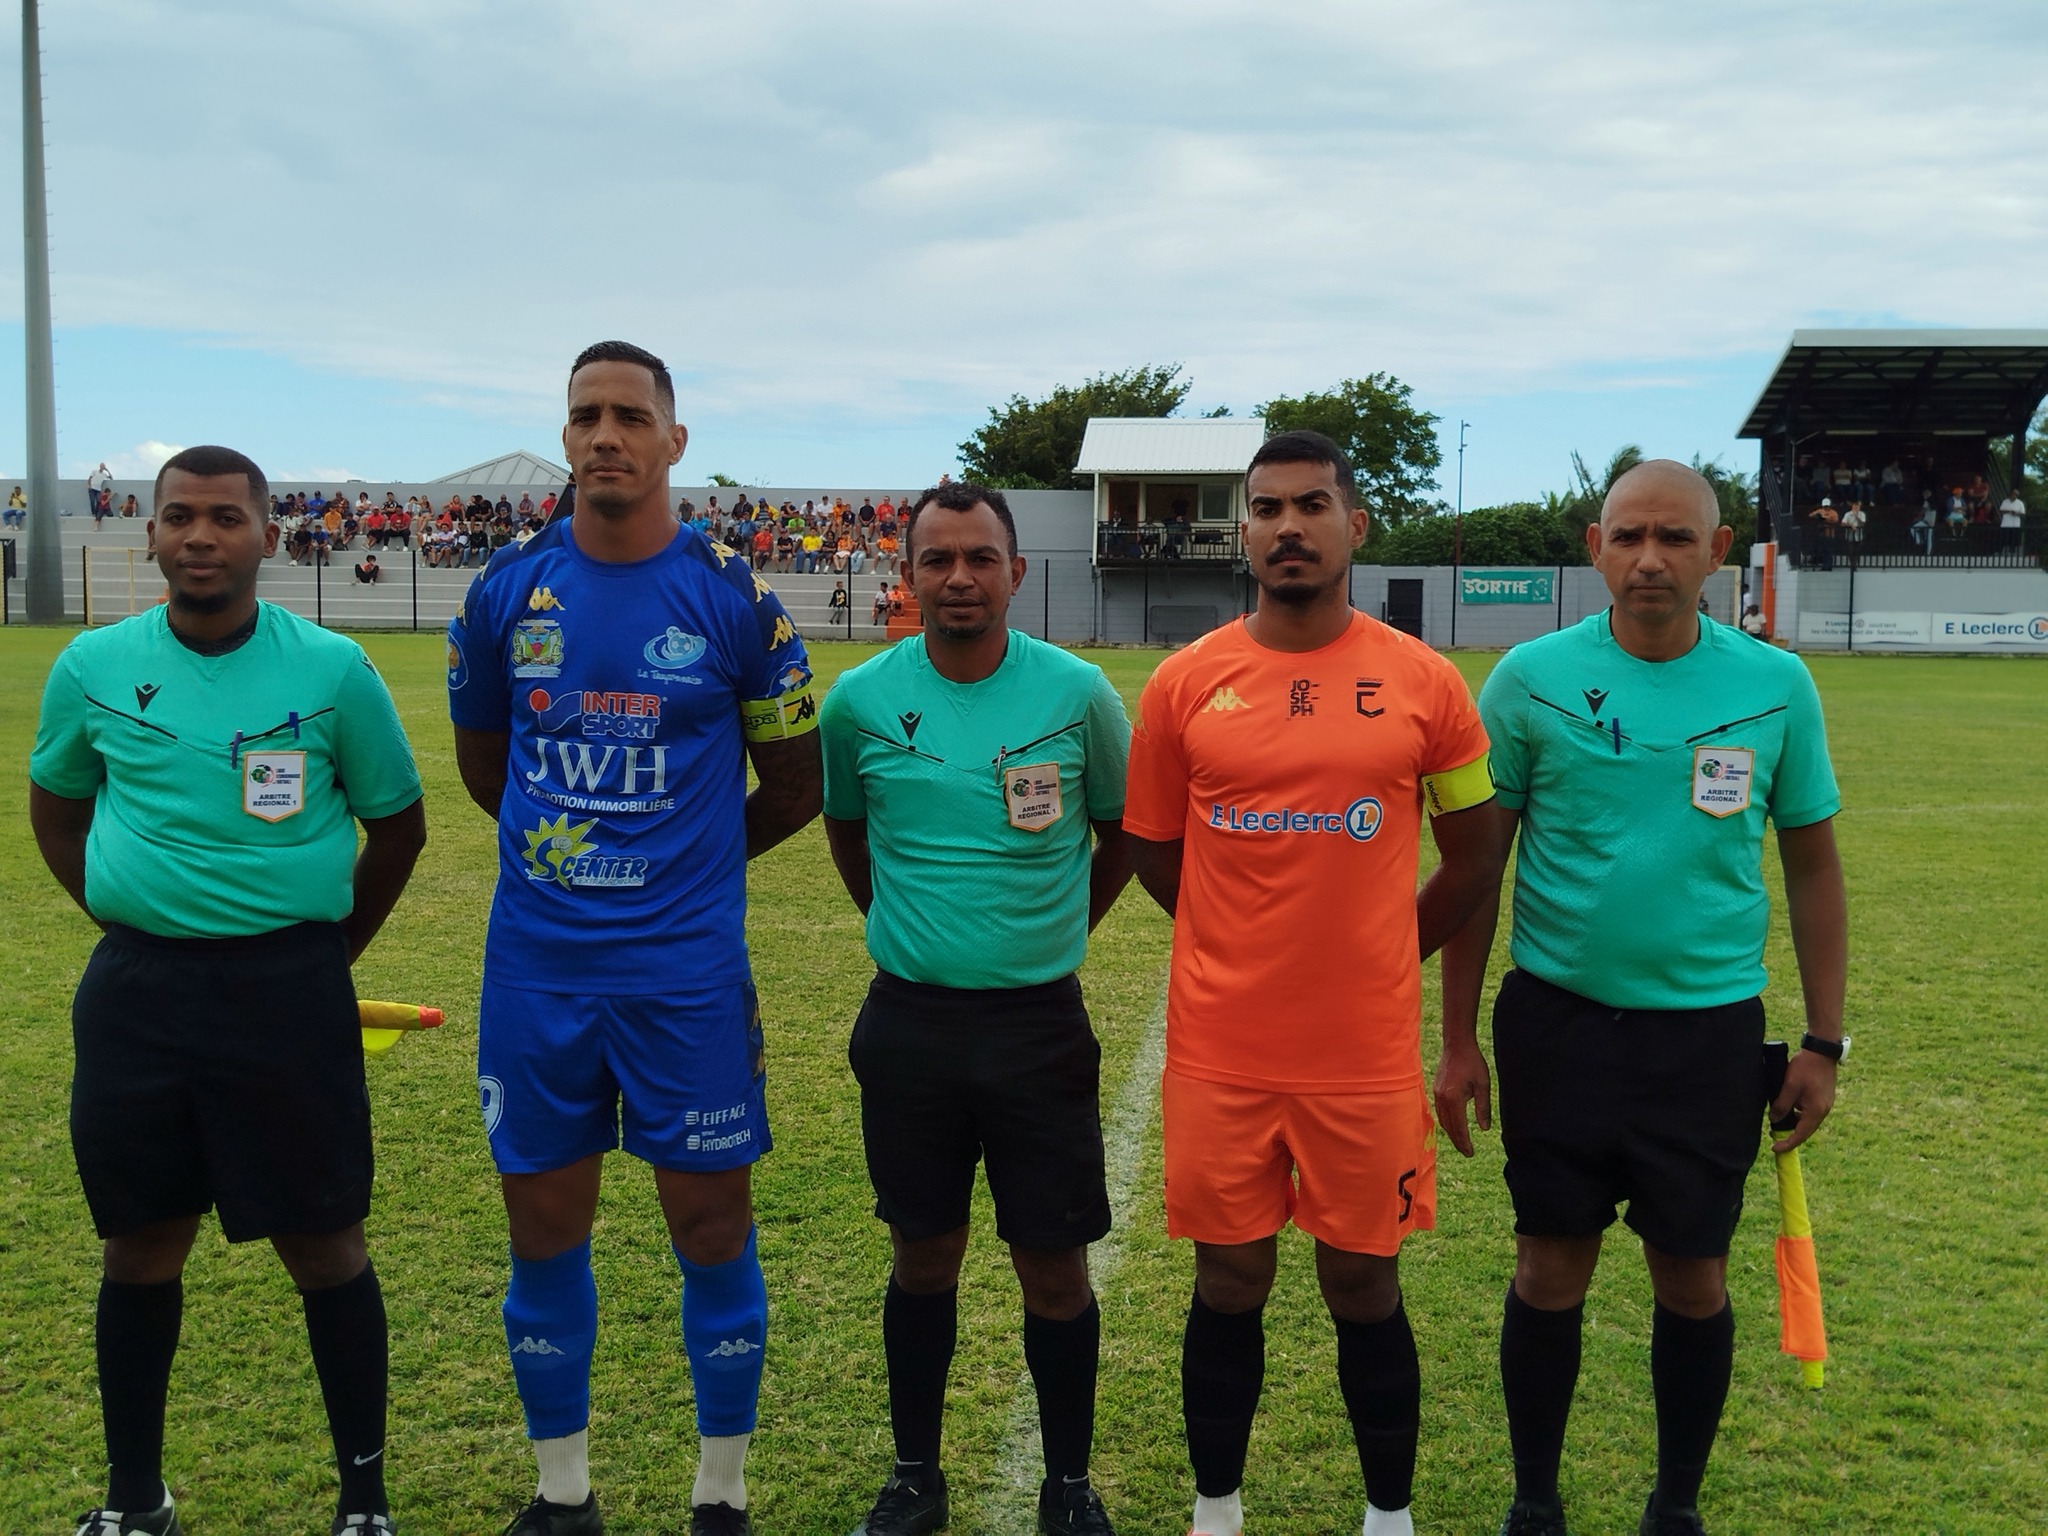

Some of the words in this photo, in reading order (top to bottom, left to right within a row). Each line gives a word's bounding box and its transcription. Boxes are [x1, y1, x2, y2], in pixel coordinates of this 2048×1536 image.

[1463, 579, 1529, 594] SORTIE
[583, 691, 661, 717] INTER
[582, 714, 660, 739] SPORT
[526, 737, 671, 795] JWH
[588, 798, 675, 813] IMMOBILIÈRE
[1700, 795, 1737, 803] REGIONAL
[1017, 810, 1051, 820] REGIONAL
[1022, 803, 1051, 813] ARBITRE
[1398, 1167, 1417, 1225] 5
